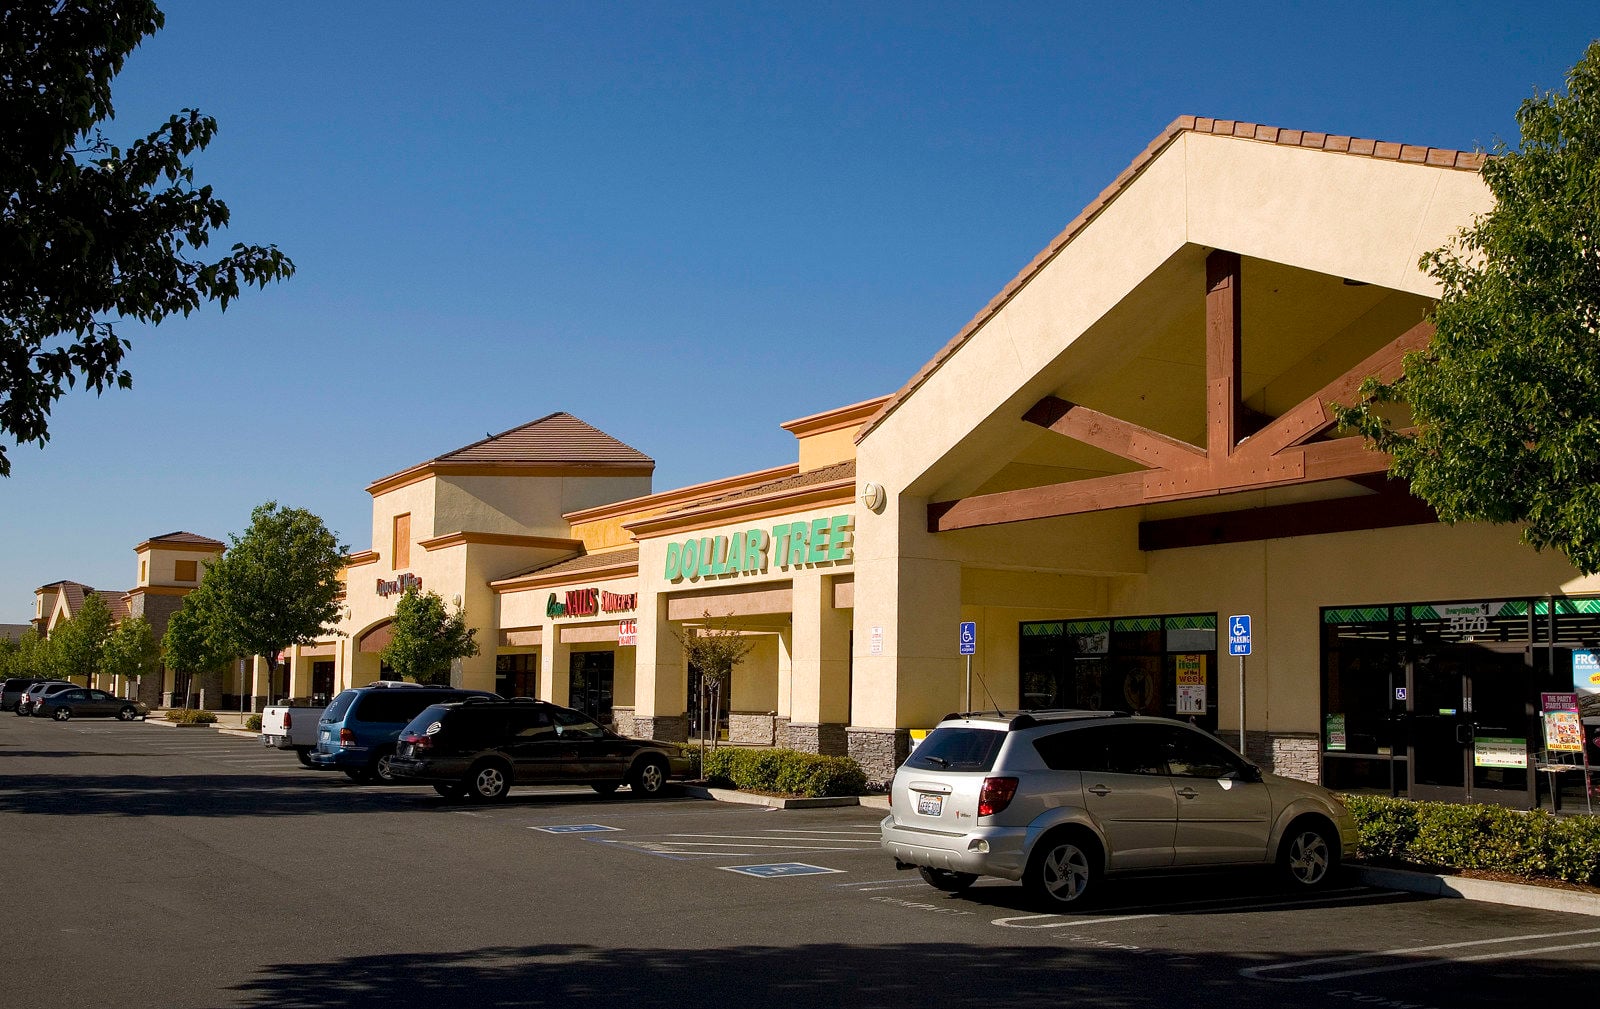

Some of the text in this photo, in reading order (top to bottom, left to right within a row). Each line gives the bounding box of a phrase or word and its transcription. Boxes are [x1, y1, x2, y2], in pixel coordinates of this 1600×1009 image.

[664, 514, 855, 584] DOLLAR TREE
[565, 588, 599, 617] NAILS
[620, 620, 638, 635] CIG
[1450, 617, 1487, 633] 5170
[1230, 635, 1250, 643] PARKING
[1234, 645, 1247, 653] ONLY
[1179, 659, 1200, 669] item
[1575, 654, 1598, 665] FRO
